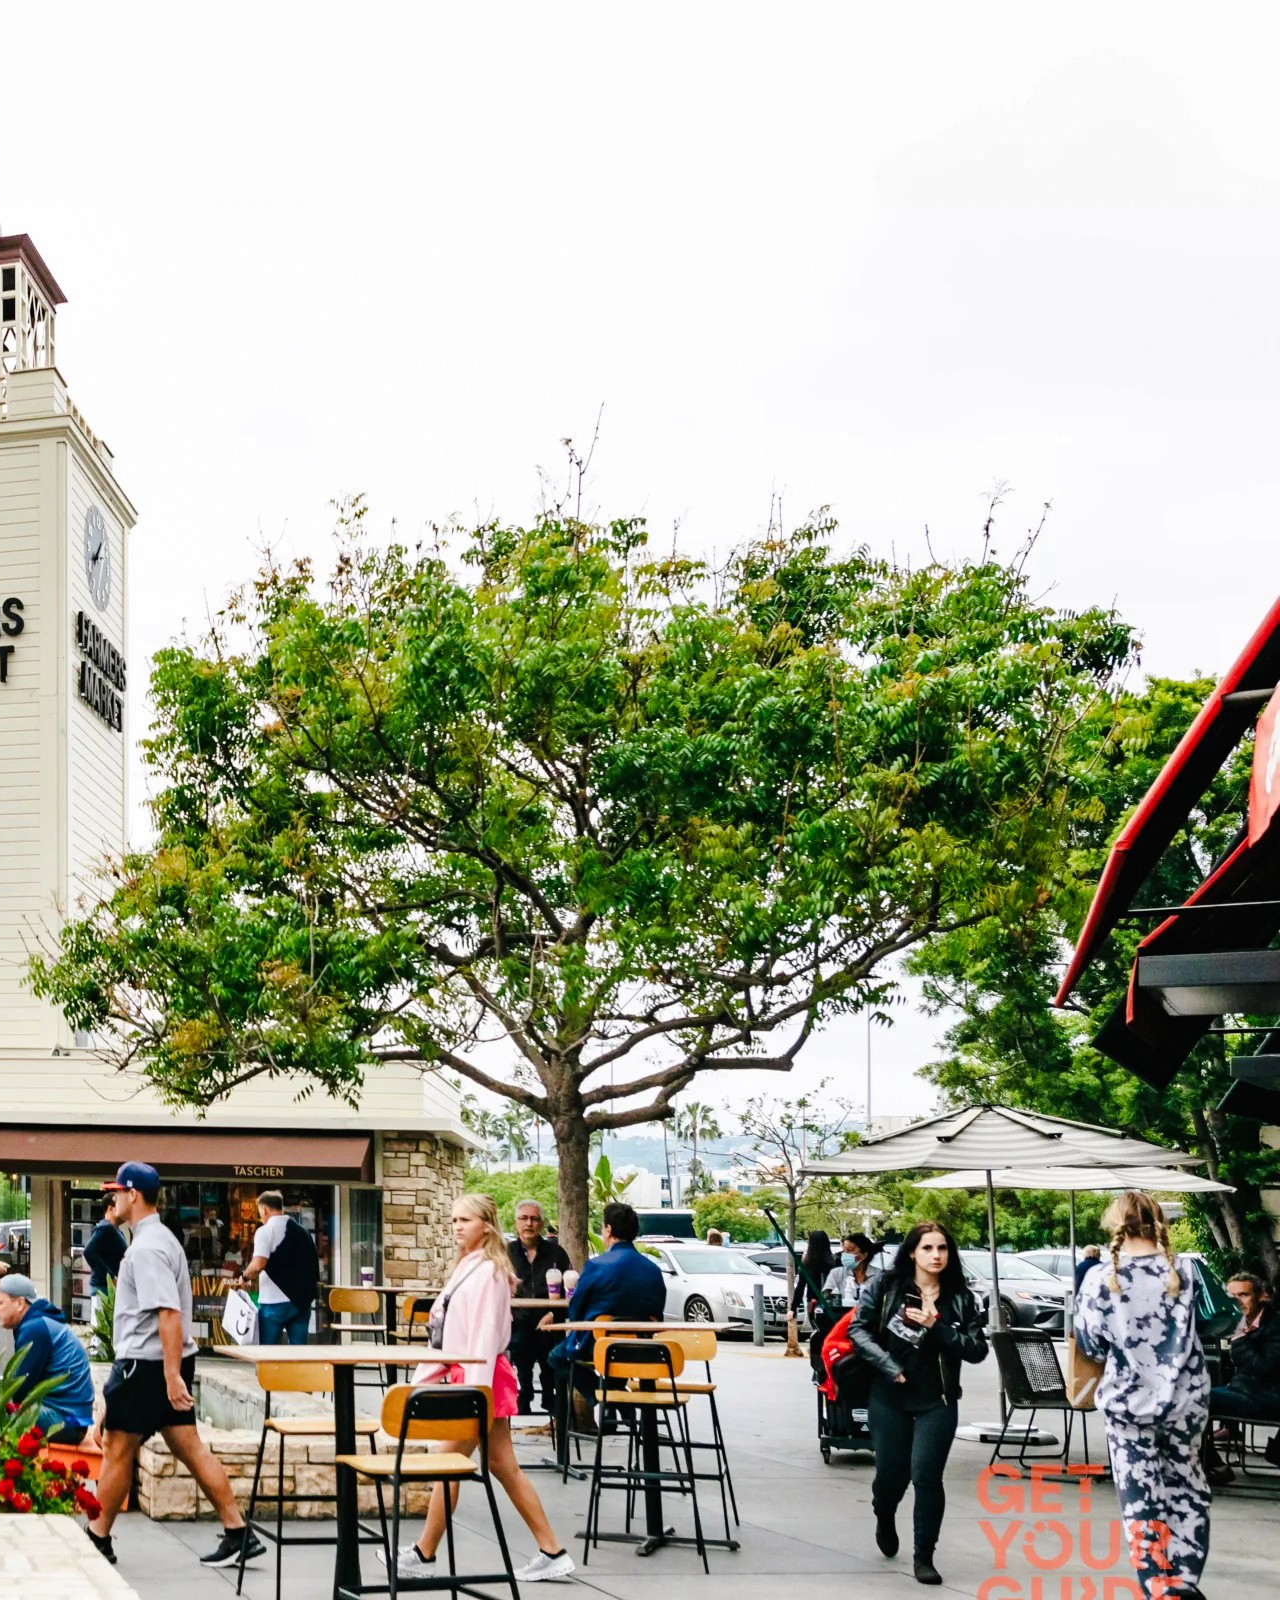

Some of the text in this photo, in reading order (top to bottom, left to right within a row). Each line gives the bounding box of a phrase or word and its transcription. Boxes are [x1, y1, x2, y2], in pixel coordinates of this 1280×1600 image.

[77, 611, 127, 692] FARMERS
[80, 661, 125, 733] MARKET
[233, 1165, 284, 1177] TASCHEN
